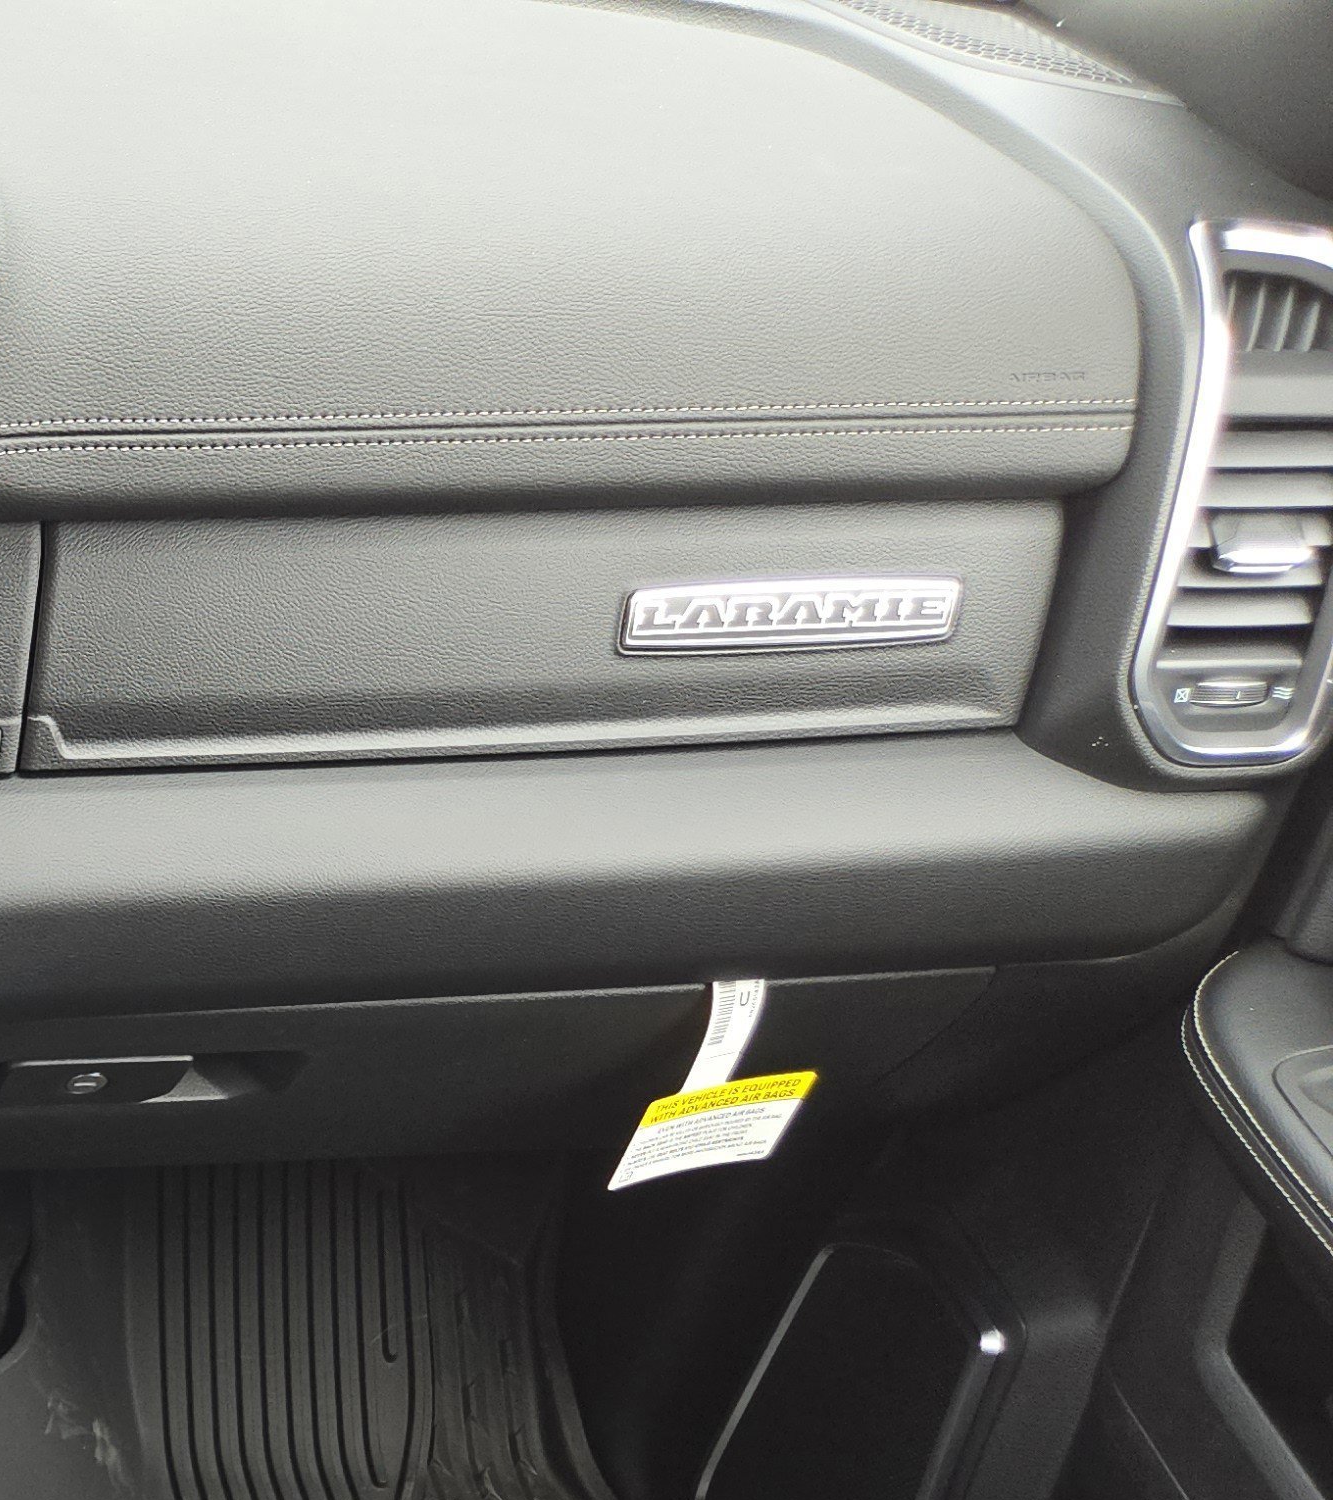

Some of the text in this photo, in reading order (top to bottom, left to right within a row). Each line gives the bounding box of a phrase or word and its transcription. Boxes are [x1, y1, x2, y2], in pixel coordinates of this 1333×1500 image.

[634, 590, 949, 633] LARAMIE
[650, 1088, 796, 1124] WITH ADVANCED AIR BAGS
[656, 1078, 802, 1112] THIS VEHICLE IS EQUIPPED
